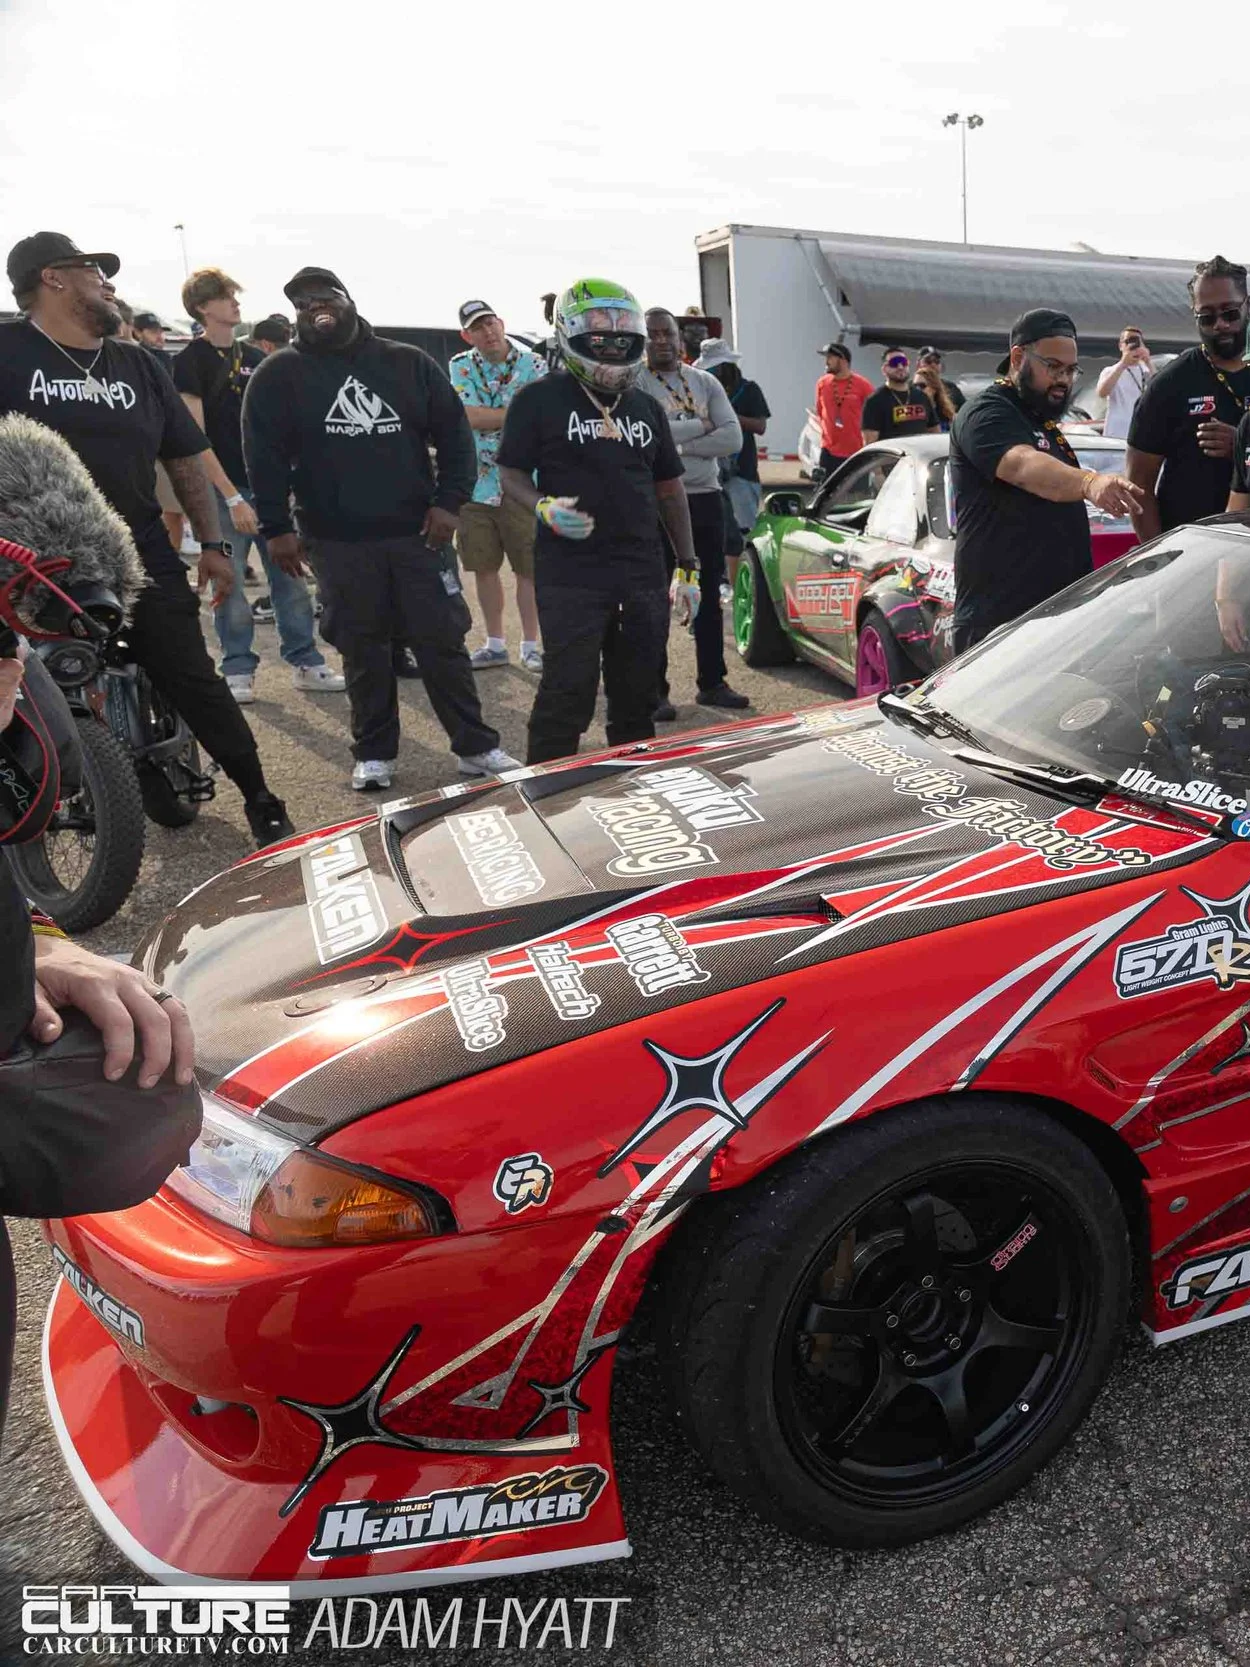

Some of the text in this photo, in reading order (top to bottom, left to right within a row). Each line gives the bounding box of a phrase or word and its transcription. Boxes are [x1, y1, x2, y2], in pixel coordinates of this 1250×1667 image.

[377, 424, 402, 434] BOY
[1118, 767, 1248, 815] UltraSlice
[594, 796, 706, 874] racing
[309, 837, 379, 955] FALKEN
[615, 916, 703, 994] Garrett
[660, 922, 693, 961] TURBO BY
[1172, 919, 1229, 941] Gram Lights
[446, 960, 499, 1047] UltraSlice
[532, 941, 593, 1017] Haltech
[1123, 970, 1190, 993] LIGHT WEIGHT CONCEPT
[53, 1246, 144, 1347] FALKEN
[393, 1501, 433, 1514] PROJECT
